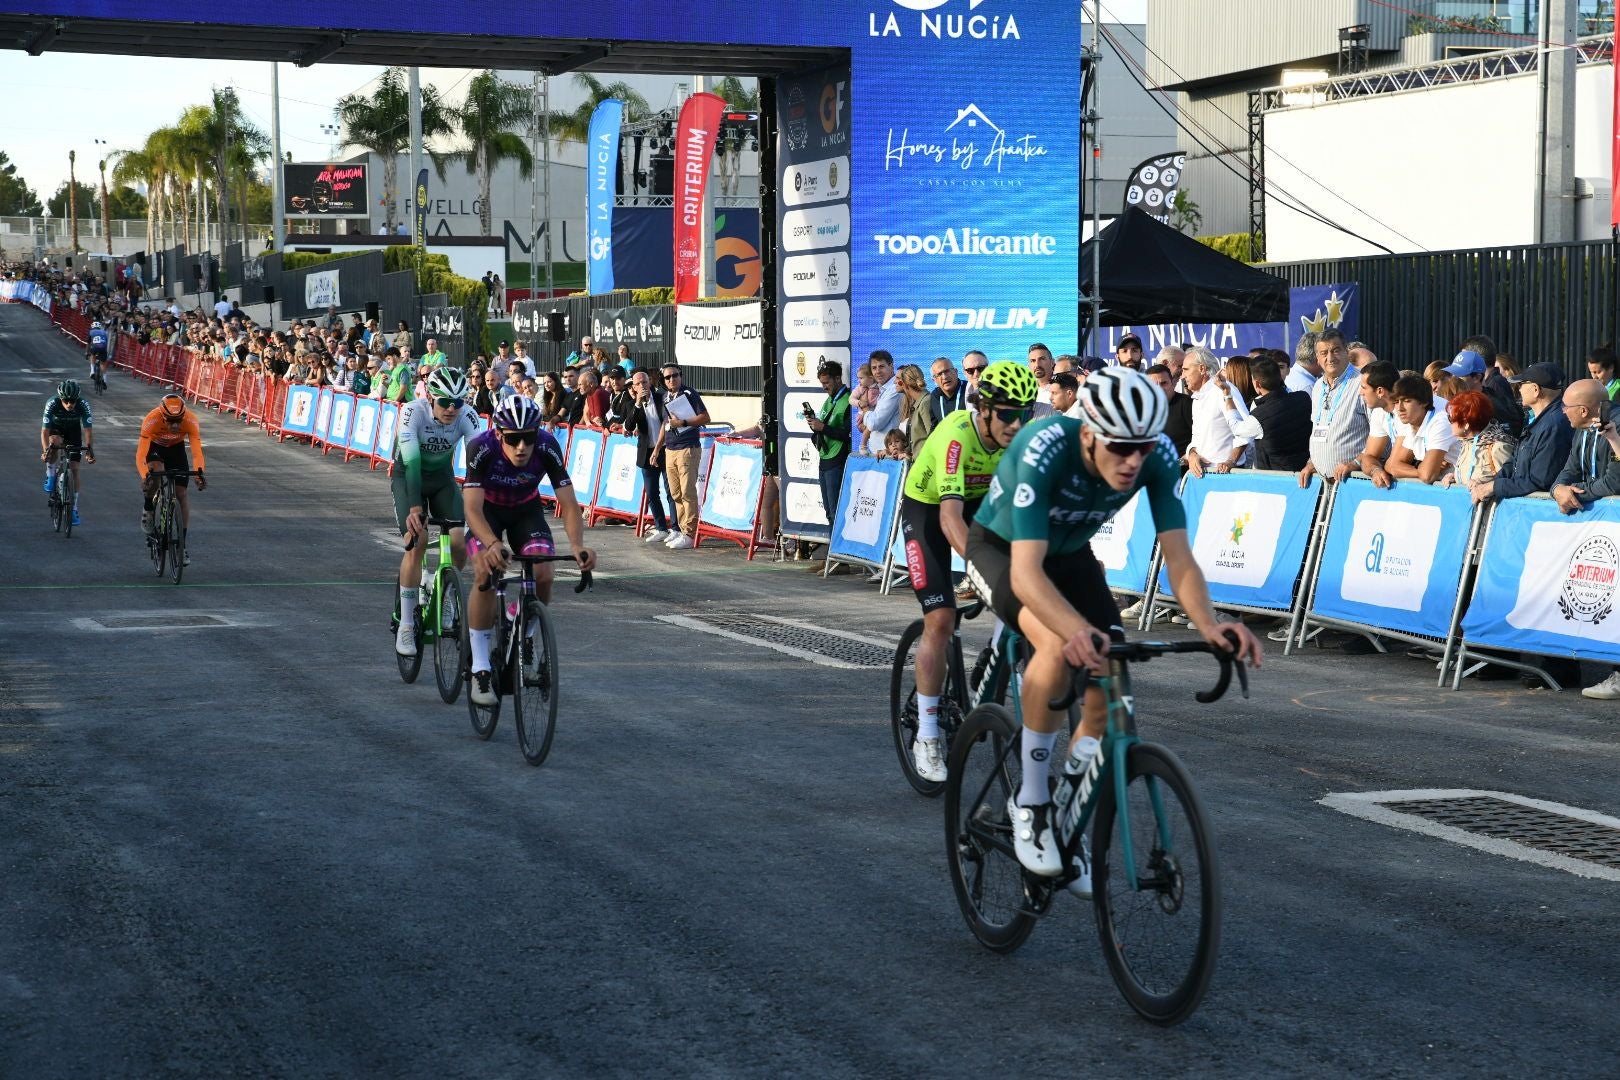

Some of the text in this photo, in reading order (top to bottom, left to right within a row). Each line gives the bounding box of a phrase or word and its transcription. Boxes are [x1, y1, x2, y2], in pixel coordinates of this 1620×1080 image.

[869, 11, 901, 37] LA
[885, 128, 946, 171] Homes
[952, 138, 978, 170] by
[683, 128, 707, 227] CRITERIUM
[597, 202, 608, 220] LA
[874, 227, 1057, 256] TODOAlicante
[793, 271, 816, 281] PODIUM
[881, 307, 1049, 330] PODIUM
[947, 445, 960, 474] SABGAL
[1023, 423, 1066, 468] KERN
[906, 542, 921, 586] SABGAL
[1570, 564, 1616, 585] CRITERIUM
